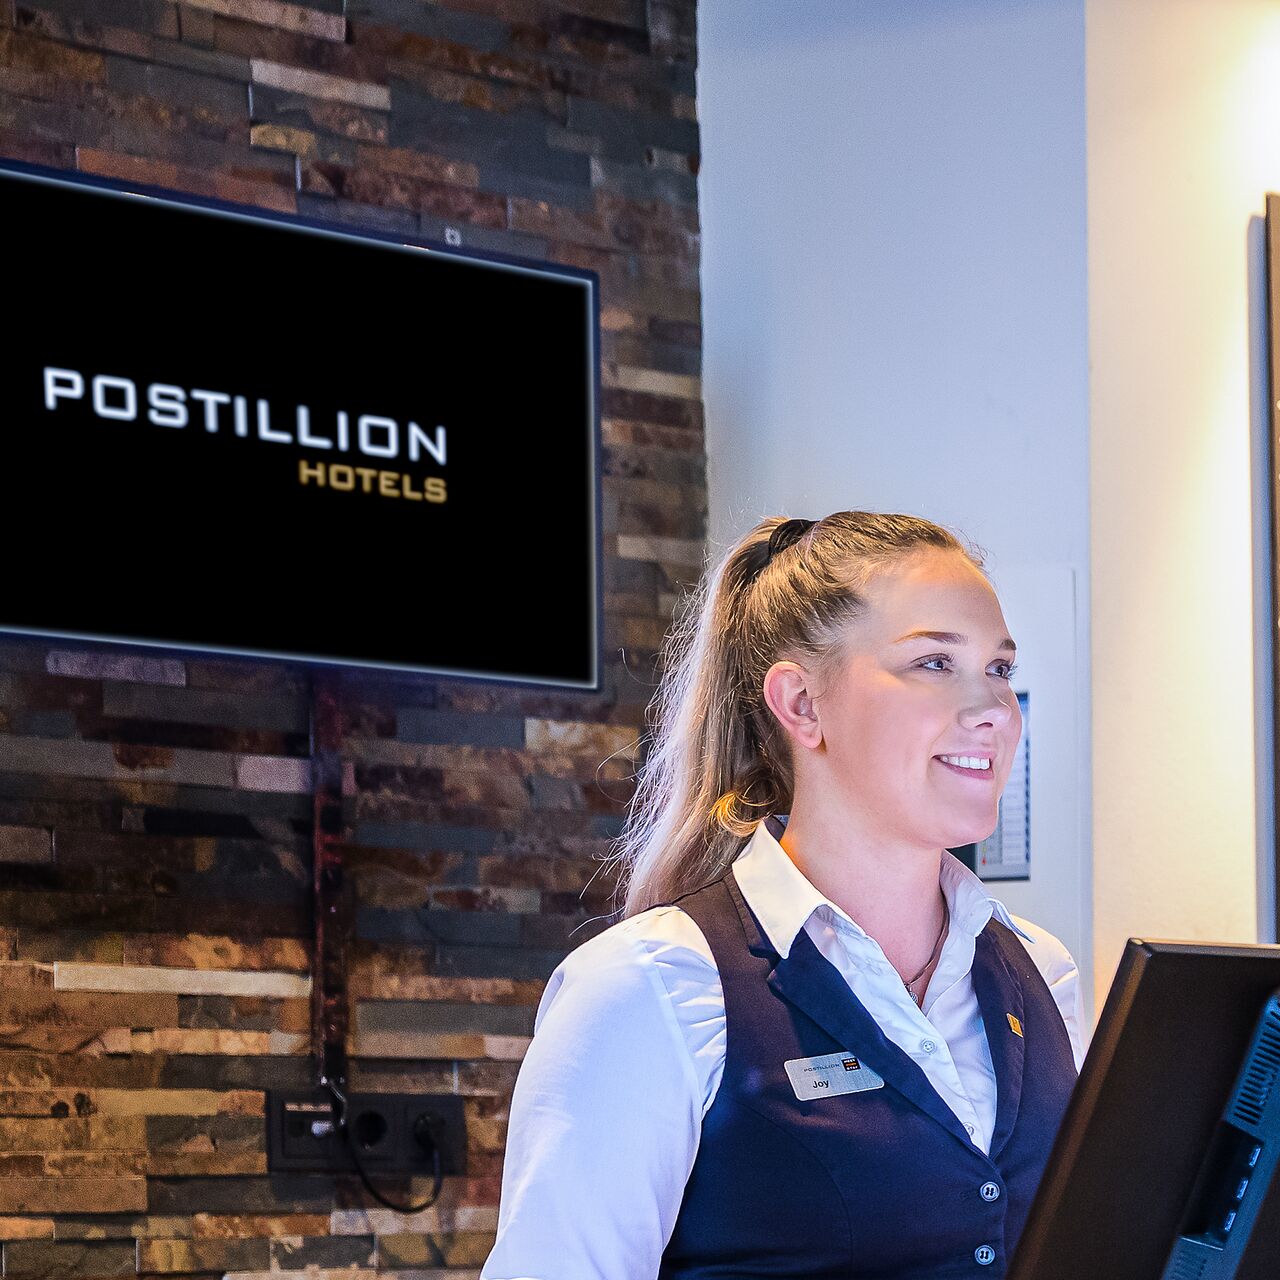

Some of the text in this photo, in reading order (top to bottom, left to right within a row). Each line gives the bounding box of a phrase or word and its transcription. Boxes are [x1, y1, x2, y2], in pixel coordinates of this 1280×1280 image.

[43, 366, 447, 466] POSTILLION
[299, 459, 447, 503] HOTELS
[812, 1080, 829, 1089] Joy
